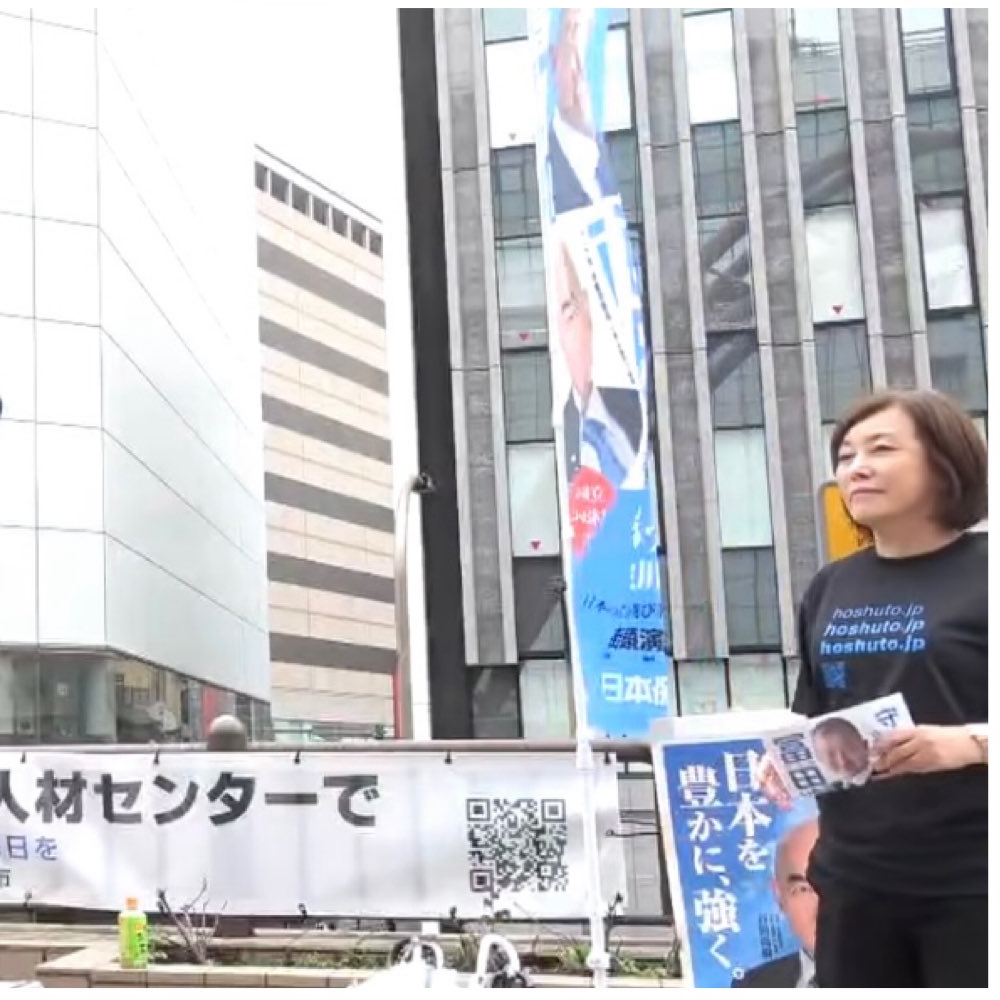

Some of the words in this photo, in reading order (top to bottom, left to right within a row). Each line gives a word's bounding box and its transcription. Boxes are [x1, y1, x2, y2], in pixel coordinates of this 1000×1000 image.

[832, 602, 924, 619] hoshuto.jp
[823, 618, 925, 638] hoshuto.jp
[820, 635, 926, 655] hoshuto.jp
[723, 748, 773, 871] 日本を
[679, 764, 745, 980] 豊かに、強く。
